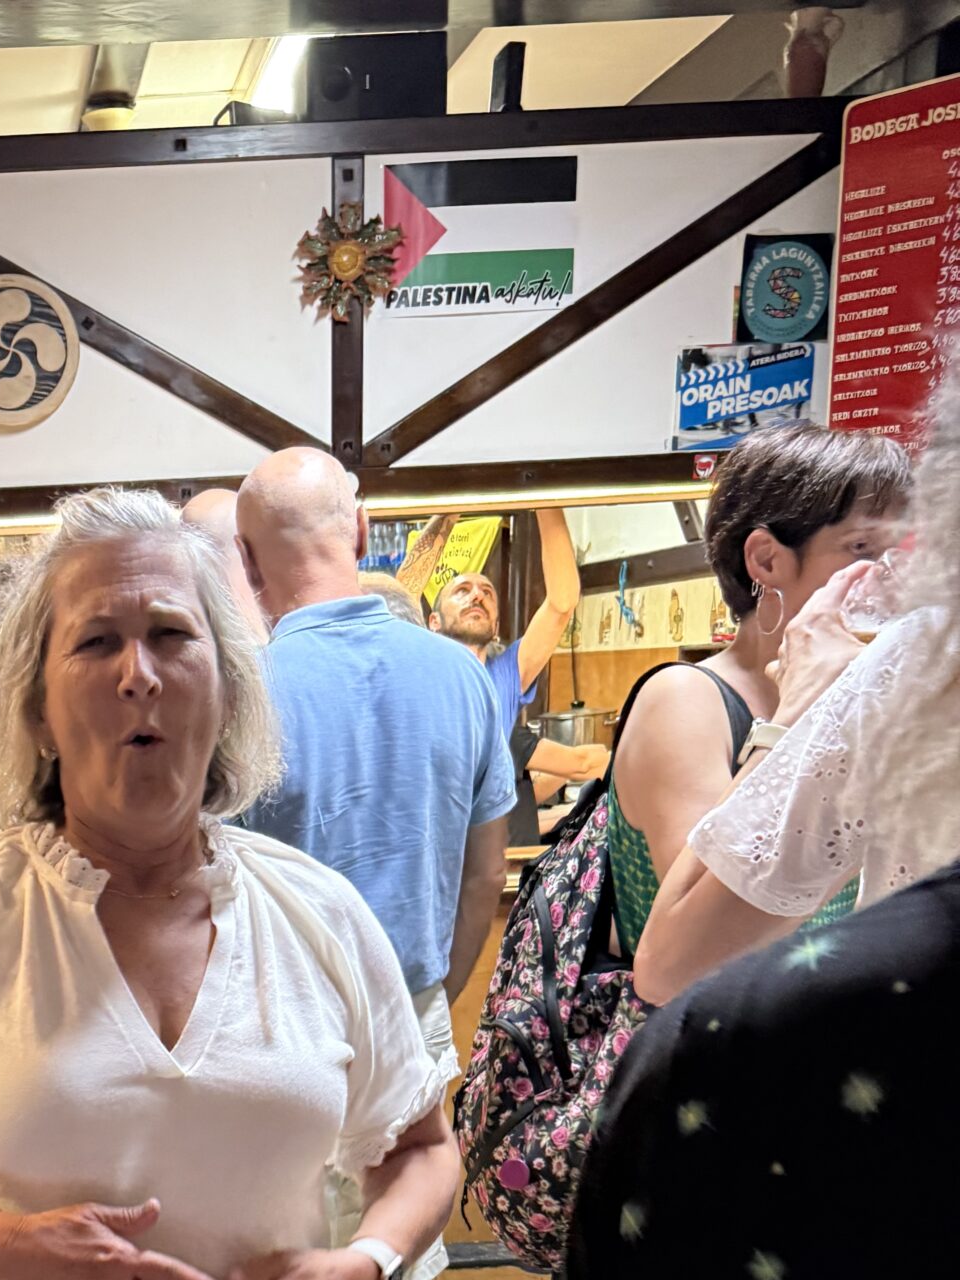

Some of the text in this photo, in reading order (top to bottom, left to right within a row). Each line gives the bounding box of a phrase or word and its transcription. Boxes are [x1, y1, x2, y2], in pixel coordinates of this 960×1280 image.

[849, 113, 920, 144] BODEGA
[385, 271, 571, 309] PALESTINA askatu!
[746, 256, 770, 316] TABERNA
[772, 247, 825, 320] LAGUNTZAILEA
[750, 355, 776, 368] ATERA
[893, 340, 927, 354] TXORIZO
[892, 360, 926, 373] TXORIZO
[682, 374, 751, 406] ORAIN
[707, 379, 809, 420] PRESOAK
[832, 408, 879, 422] ARDI GAZTA
